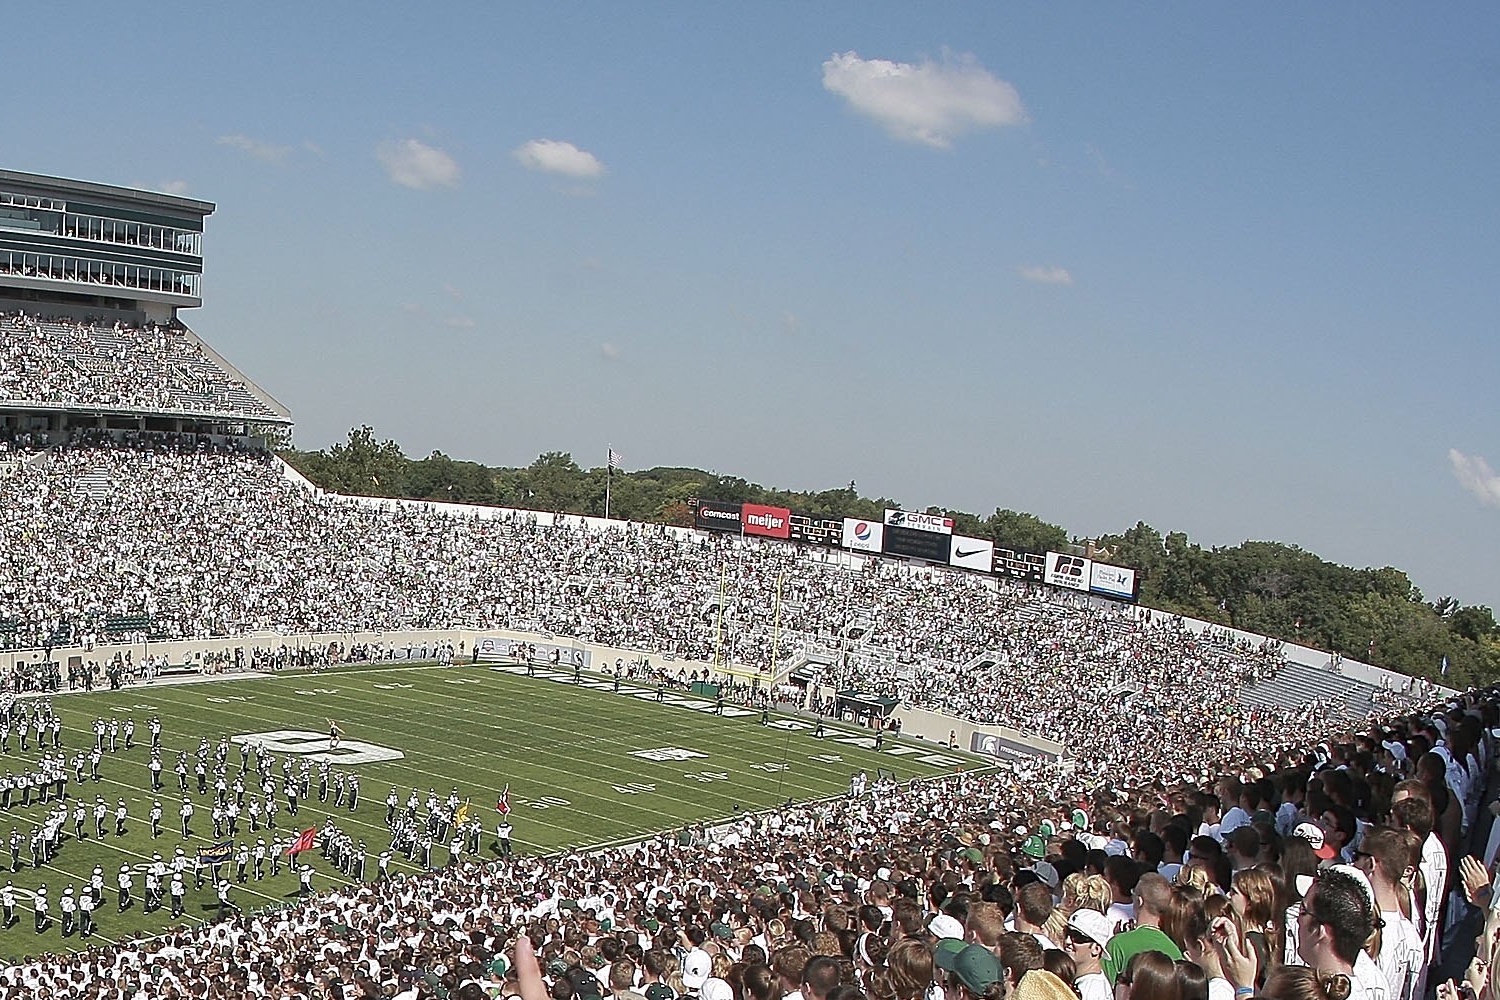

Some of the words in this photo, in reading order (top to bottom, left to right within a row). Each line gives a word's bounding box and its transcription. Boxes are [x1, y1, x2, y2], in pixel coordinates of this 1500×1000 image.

[703, 508, 740, 521] comcast
[907, 513, 941, 526] GMC
[747, 513, 784, 530] meijer
[612, 782, 656, 795] 40
[516, 795, 571, 809] 50
